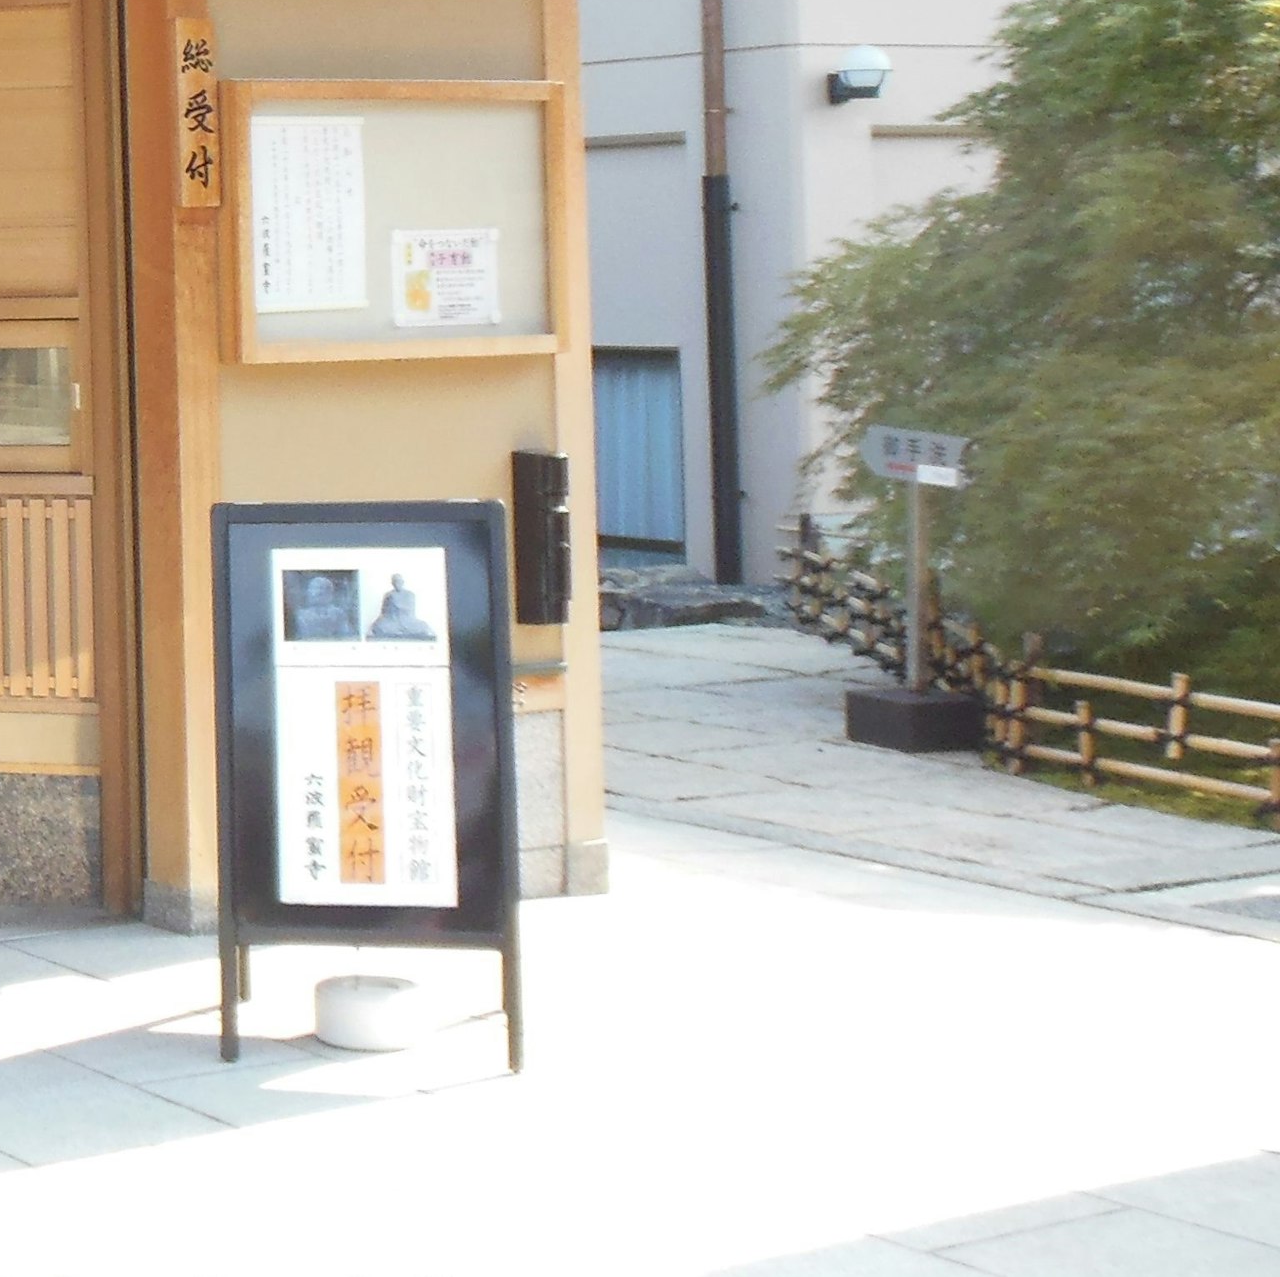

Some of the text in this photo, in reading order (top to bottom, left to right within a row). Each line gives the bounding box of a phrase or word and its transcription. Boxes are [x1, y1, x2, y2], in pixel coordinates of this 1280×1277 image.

[181, 38, 215, 188] 総受付
[303, 773, 327, 881] 六波羅蜜寺
[341, 683, 379, 883] 拝観受付
[405, 685, 432, 882] 重要文化財宝物館
